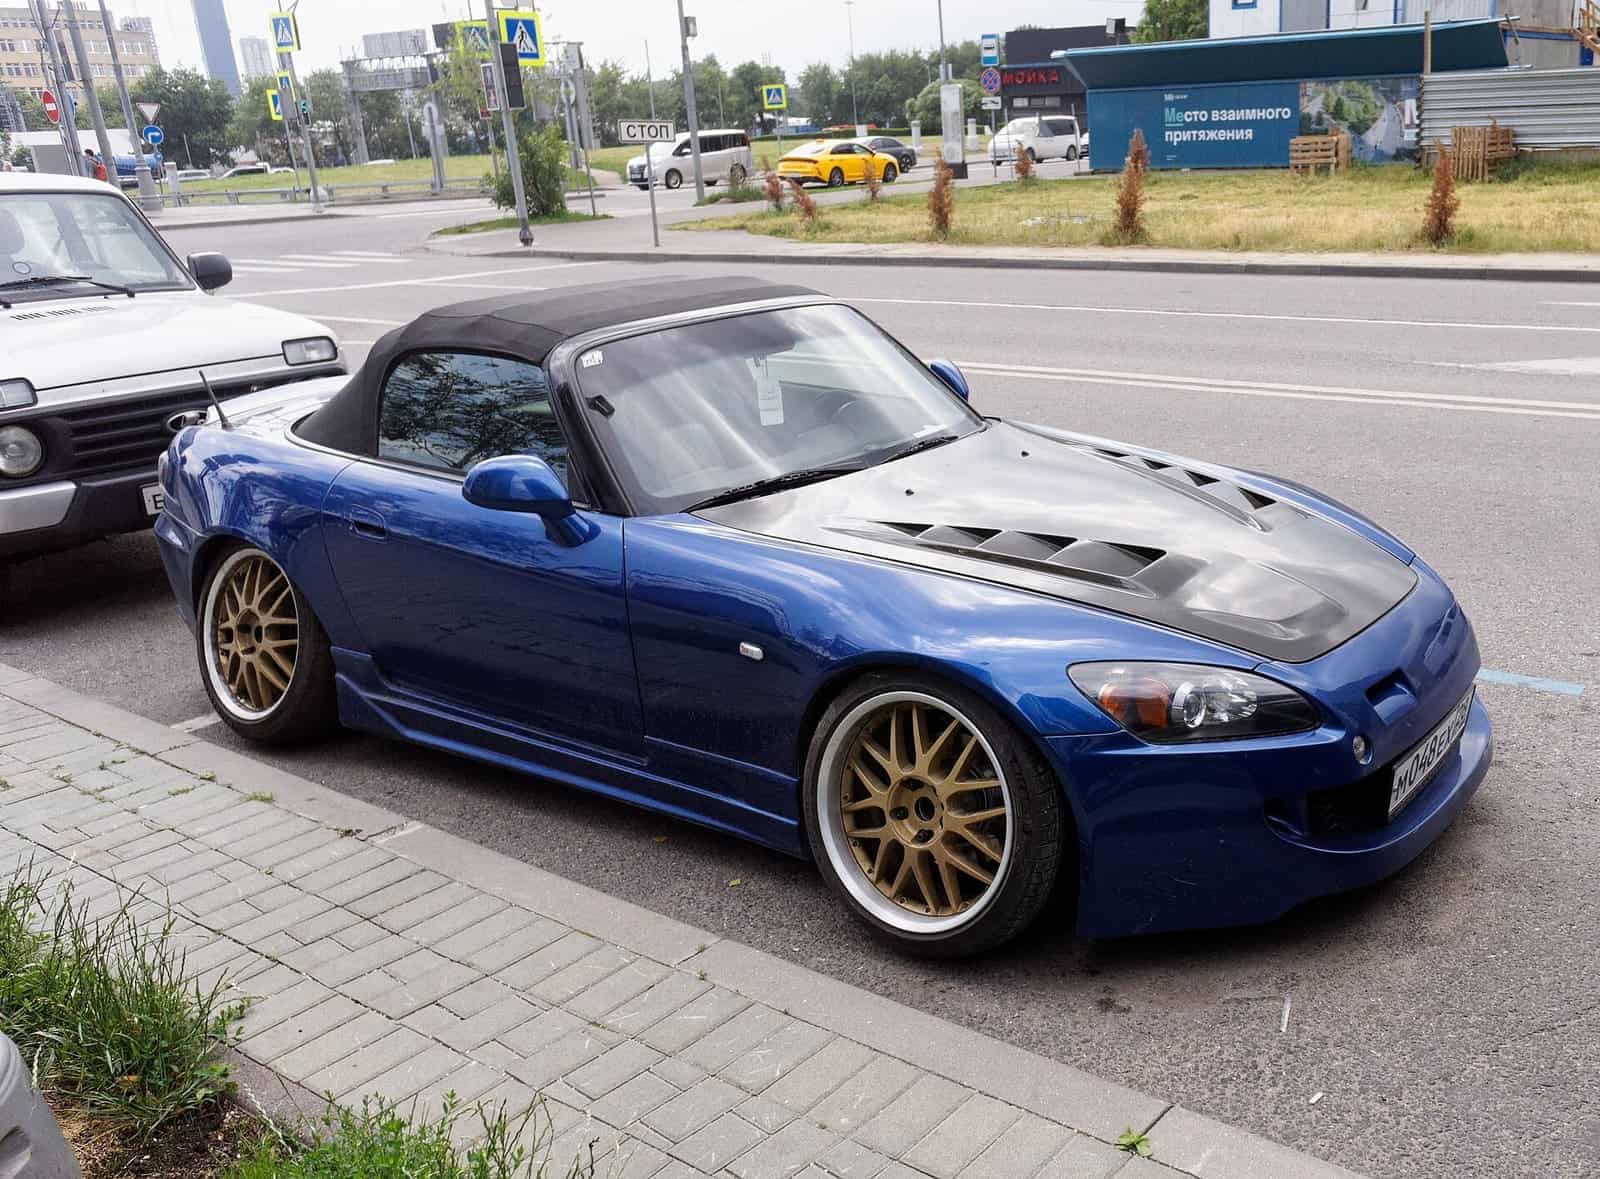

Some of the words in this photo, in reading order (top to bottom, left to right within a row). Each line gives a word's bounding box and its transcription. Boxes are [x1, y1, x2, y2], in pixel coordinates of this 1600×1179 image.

[1165, 107, 1208, 122] Место
[1211, 107, 1291, 121] взаимного
[626, 124, 669, 139] СТОП
[1165, 129, 1253, 146] притяжения
